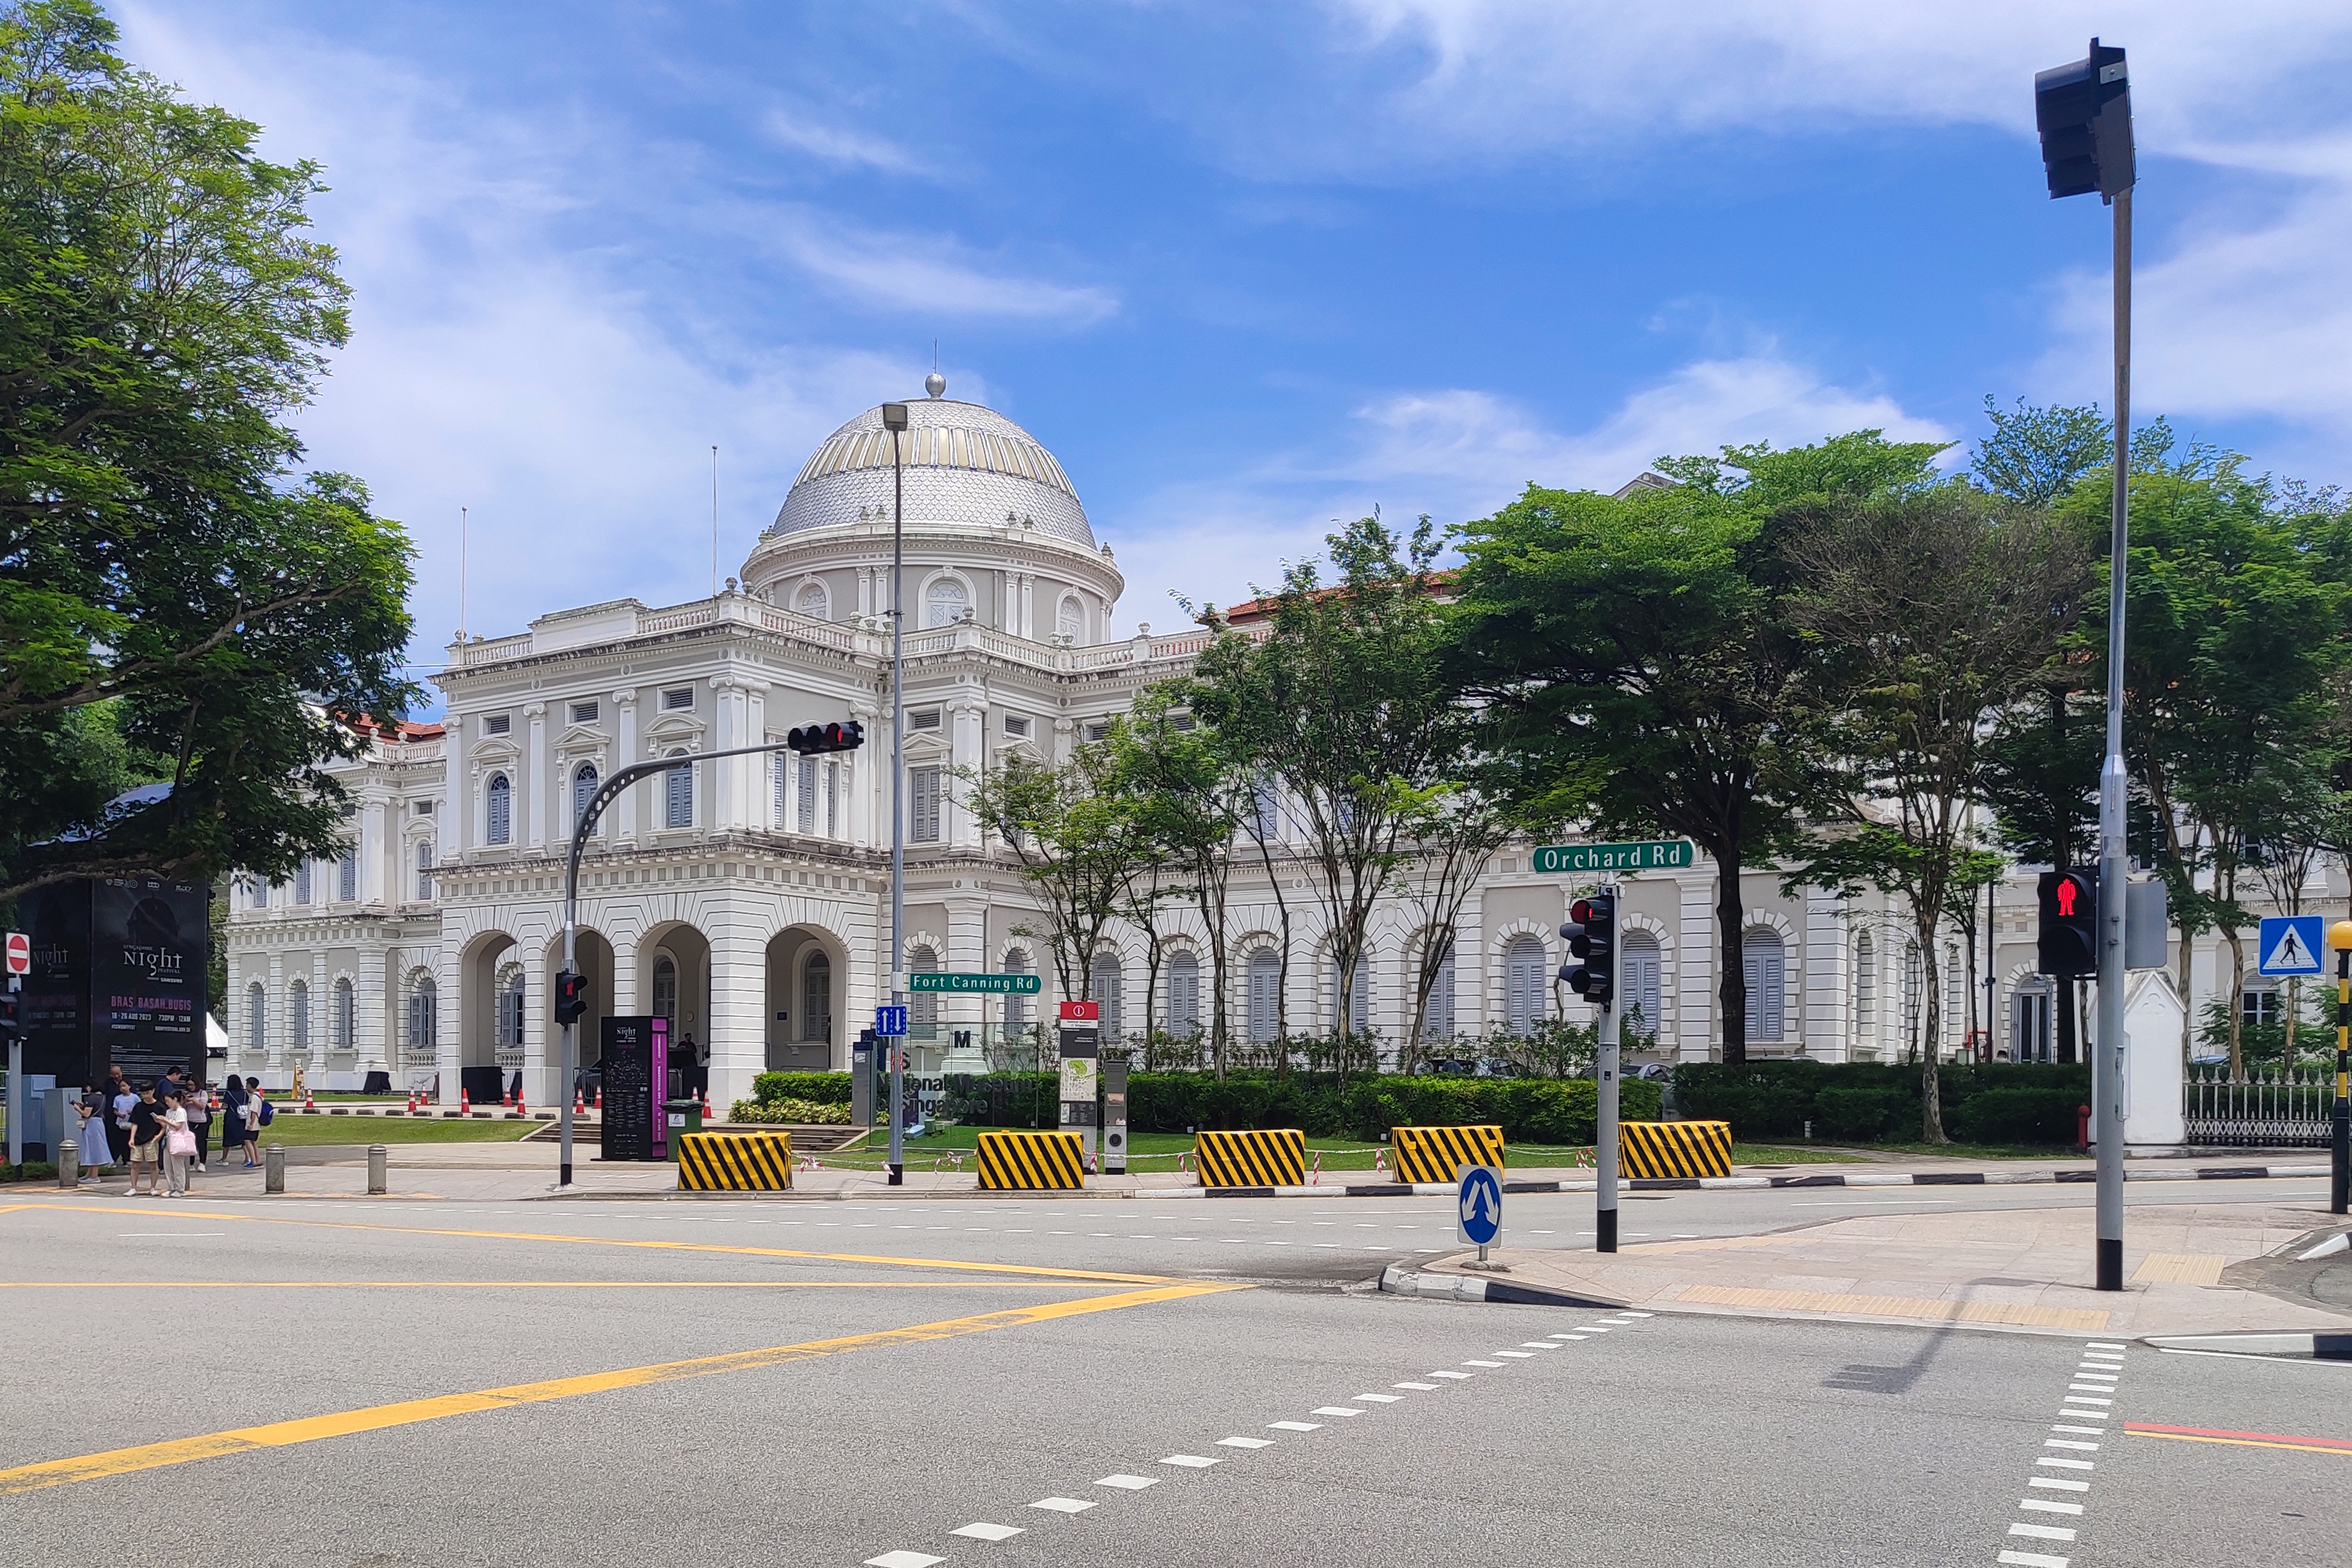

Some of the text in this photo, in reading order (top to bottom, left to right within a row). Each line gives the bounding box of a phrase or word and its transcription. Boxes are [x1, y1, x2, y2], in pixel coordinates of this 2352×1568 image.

[1544, 844, 1680, 870] Orchard Rd
[913, 975, 1033, 991] Fort Canning Rd
[111, 995, 134, 1008] BRAS
[954, 1031, 971, 1048] M
[953, 1074, 1033, 1093] Museum
